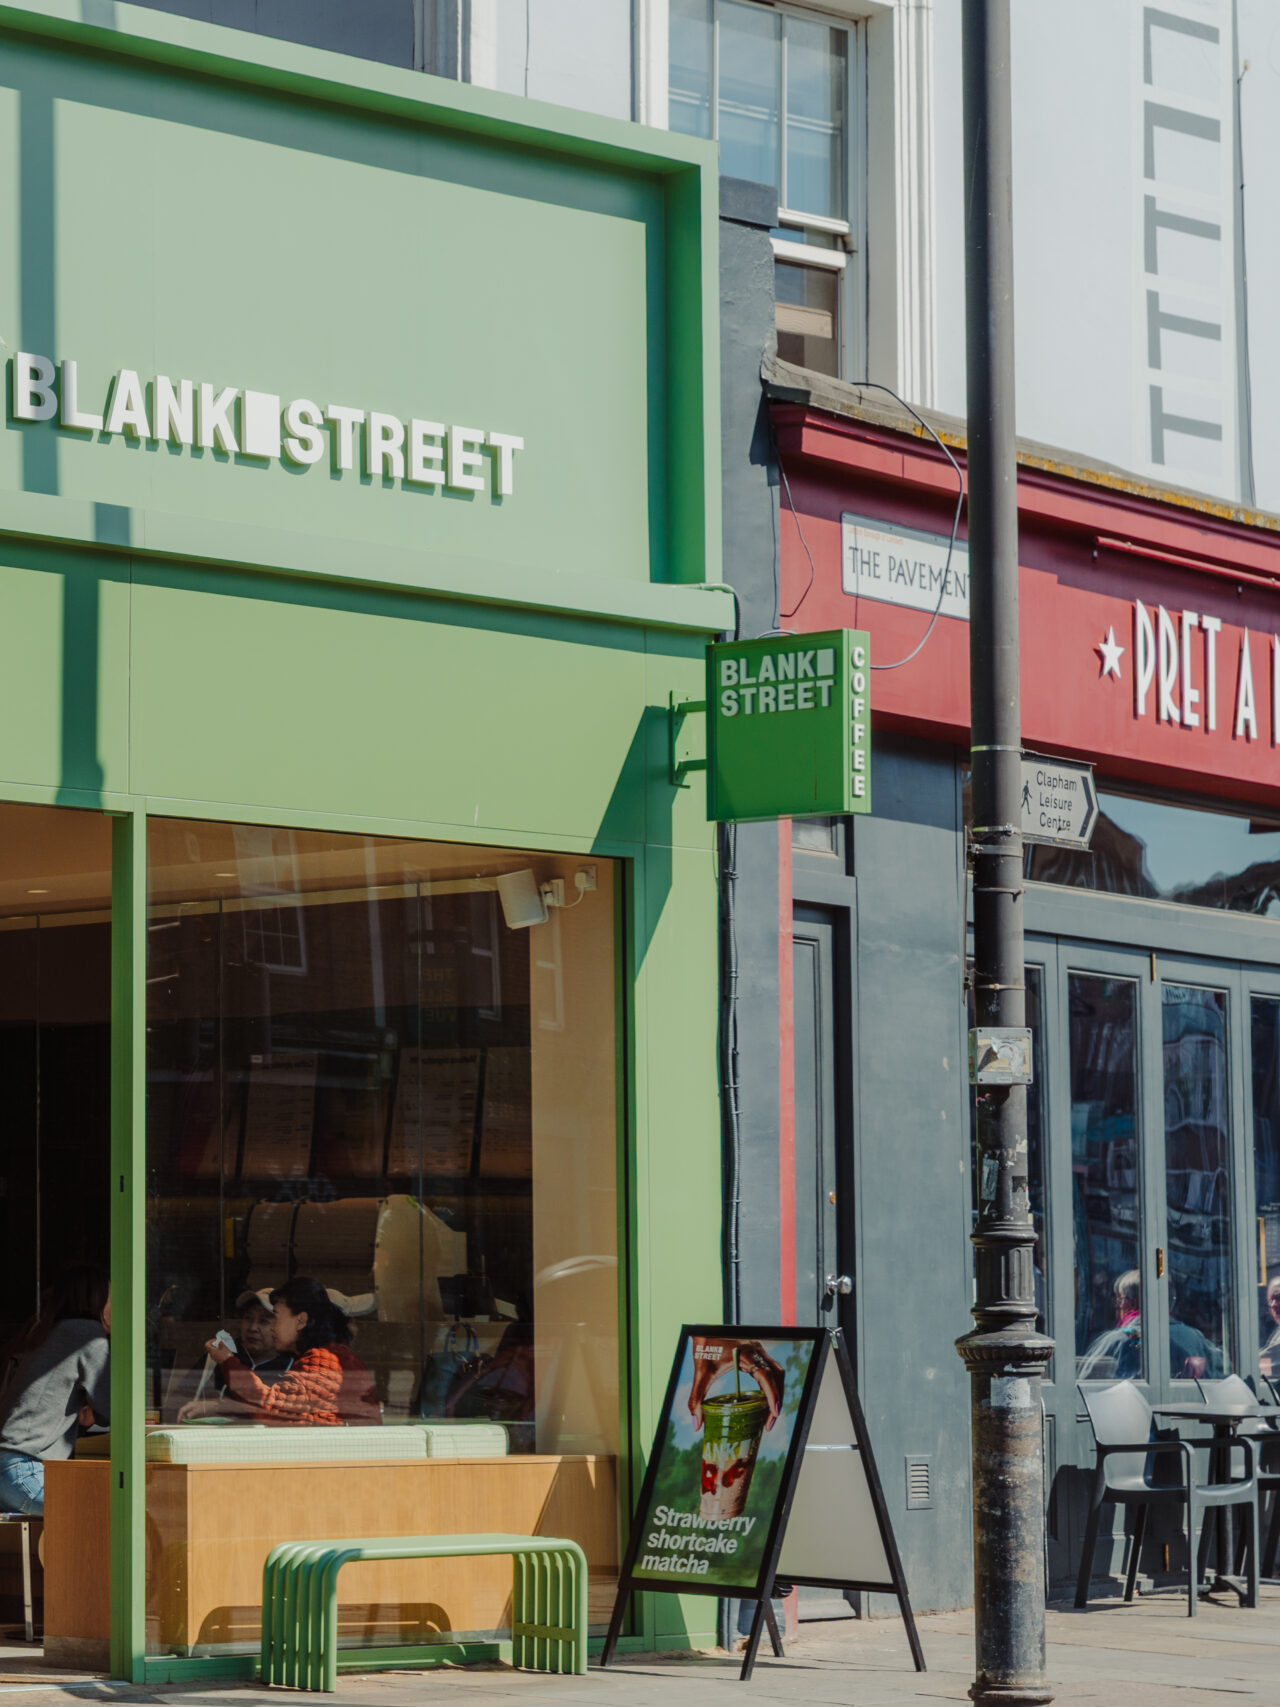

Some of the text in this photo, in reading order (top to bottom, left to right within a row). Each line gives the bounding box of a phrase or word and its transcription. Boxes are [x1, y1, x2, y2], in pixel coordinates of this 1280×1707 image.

[13, 351, 524, 495] BLANK STREET
[848, 546, 970, 600] THE PAVEMEN
[720, 650, 816, 687] BLANK
[1136, 598, 1222, 731] PRET
[1236, 625, 1258, 740] A
[720, 679, 835, 718] STREET
[852, 646, 866, 796] COFFEE
[1036, 770, 1077, 792] Clapham
[1039, 791, 1073, 811] Leisure
[1039, 811, 1072, 831] Centre
[647, 1528, 738, 1554] shortcake
[641, 1554, 709, 1575] matcha
